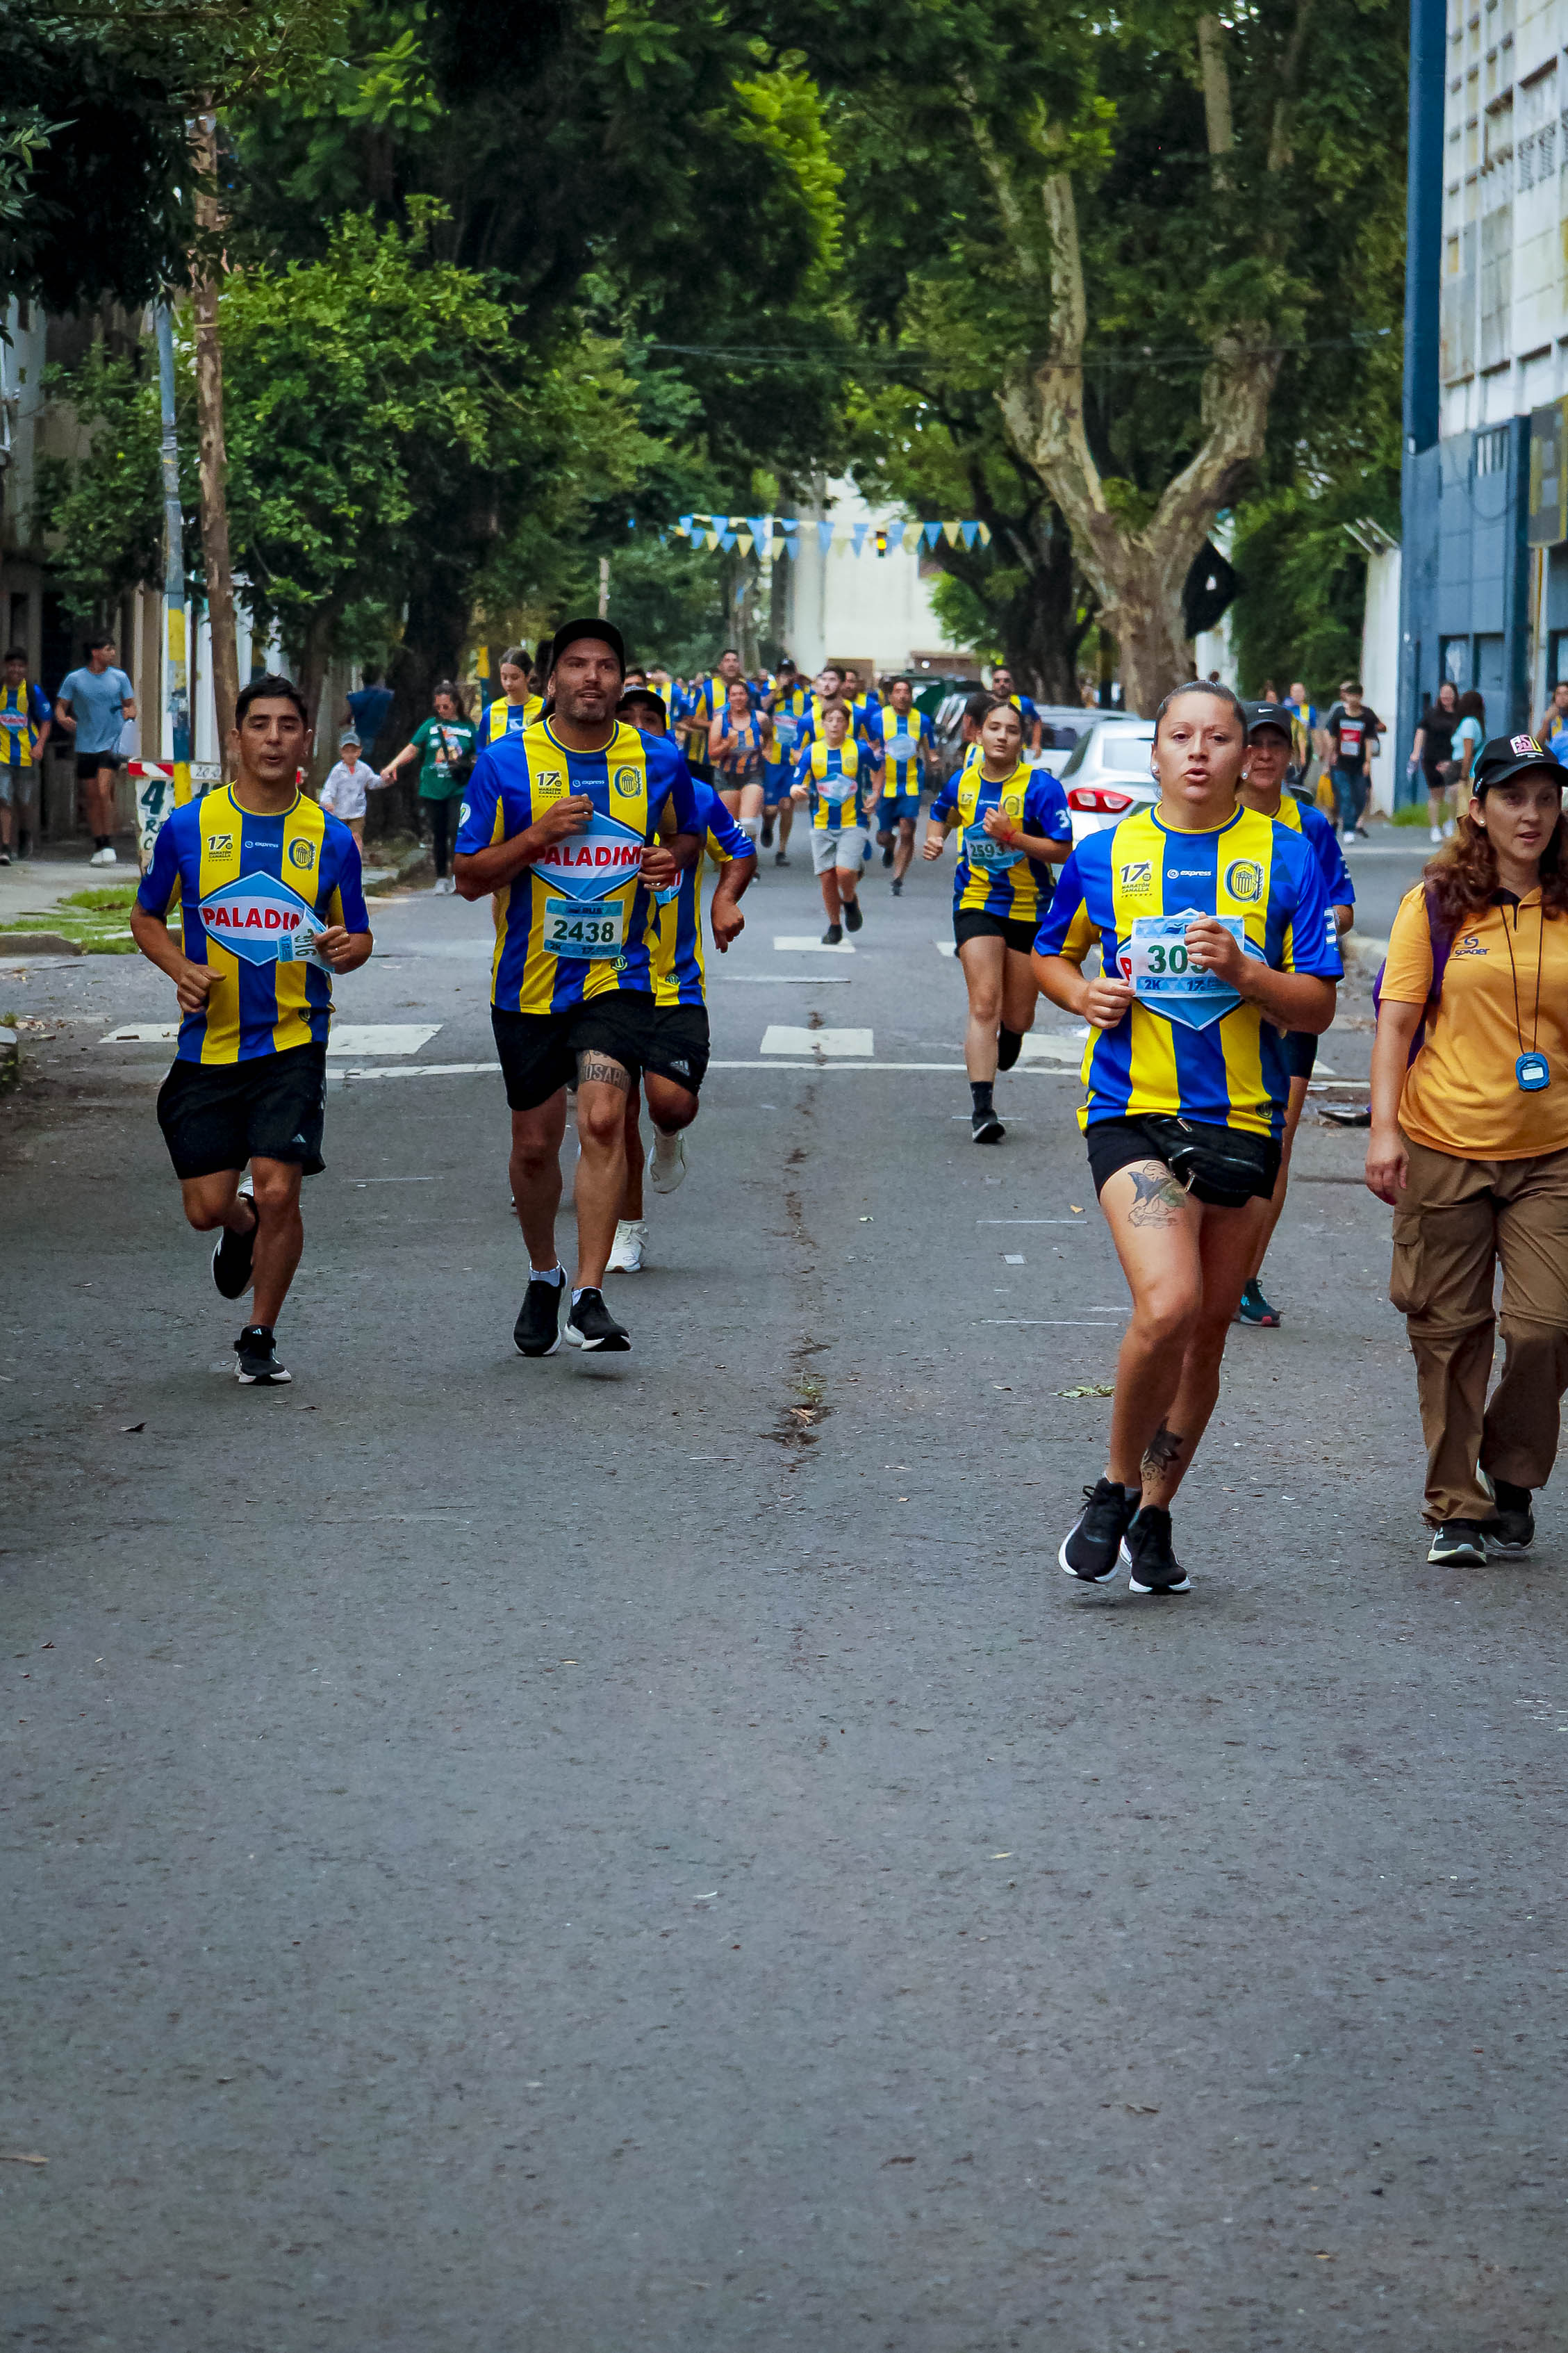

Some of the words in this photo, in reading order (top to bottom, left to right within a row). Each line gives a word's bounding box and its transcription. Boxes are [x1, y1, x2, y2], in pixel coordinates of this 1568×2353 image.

[536, 771, 561, 786] 17
[208, 835, 232, 851] 17
[1121, 862, 1150, 883] 17
[202, 908, 300, 931] PALADIN
[552, 919, 615, 943] 2438
[1144, 980, 1161, 990] 2K
